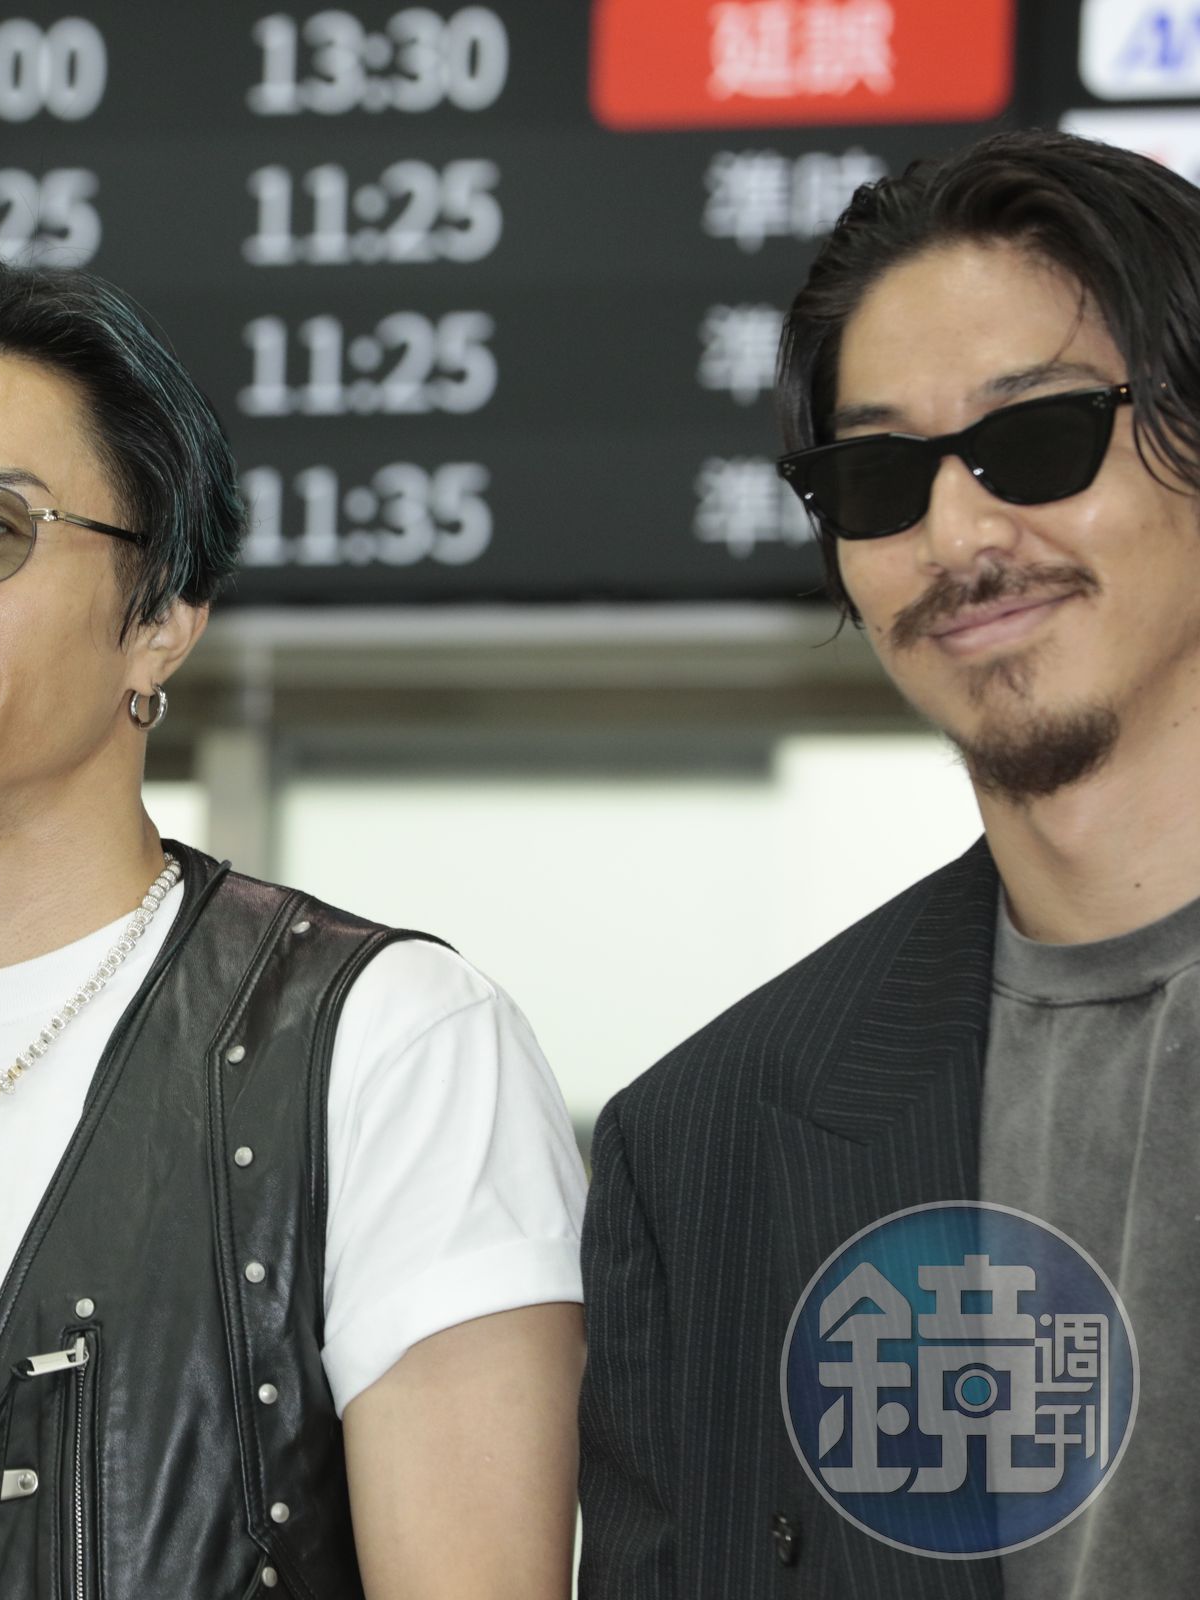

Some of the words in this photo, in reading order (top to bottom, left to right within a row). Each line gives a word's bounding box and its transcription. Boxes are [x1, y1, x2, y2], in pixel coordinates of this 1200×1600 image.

[248, 6, 509, 115] 13:30
[243, 158, 503, 266] 11:25
[240, 311, 497, 416] 11:25
[244, 462, 493, 566] 11:35
